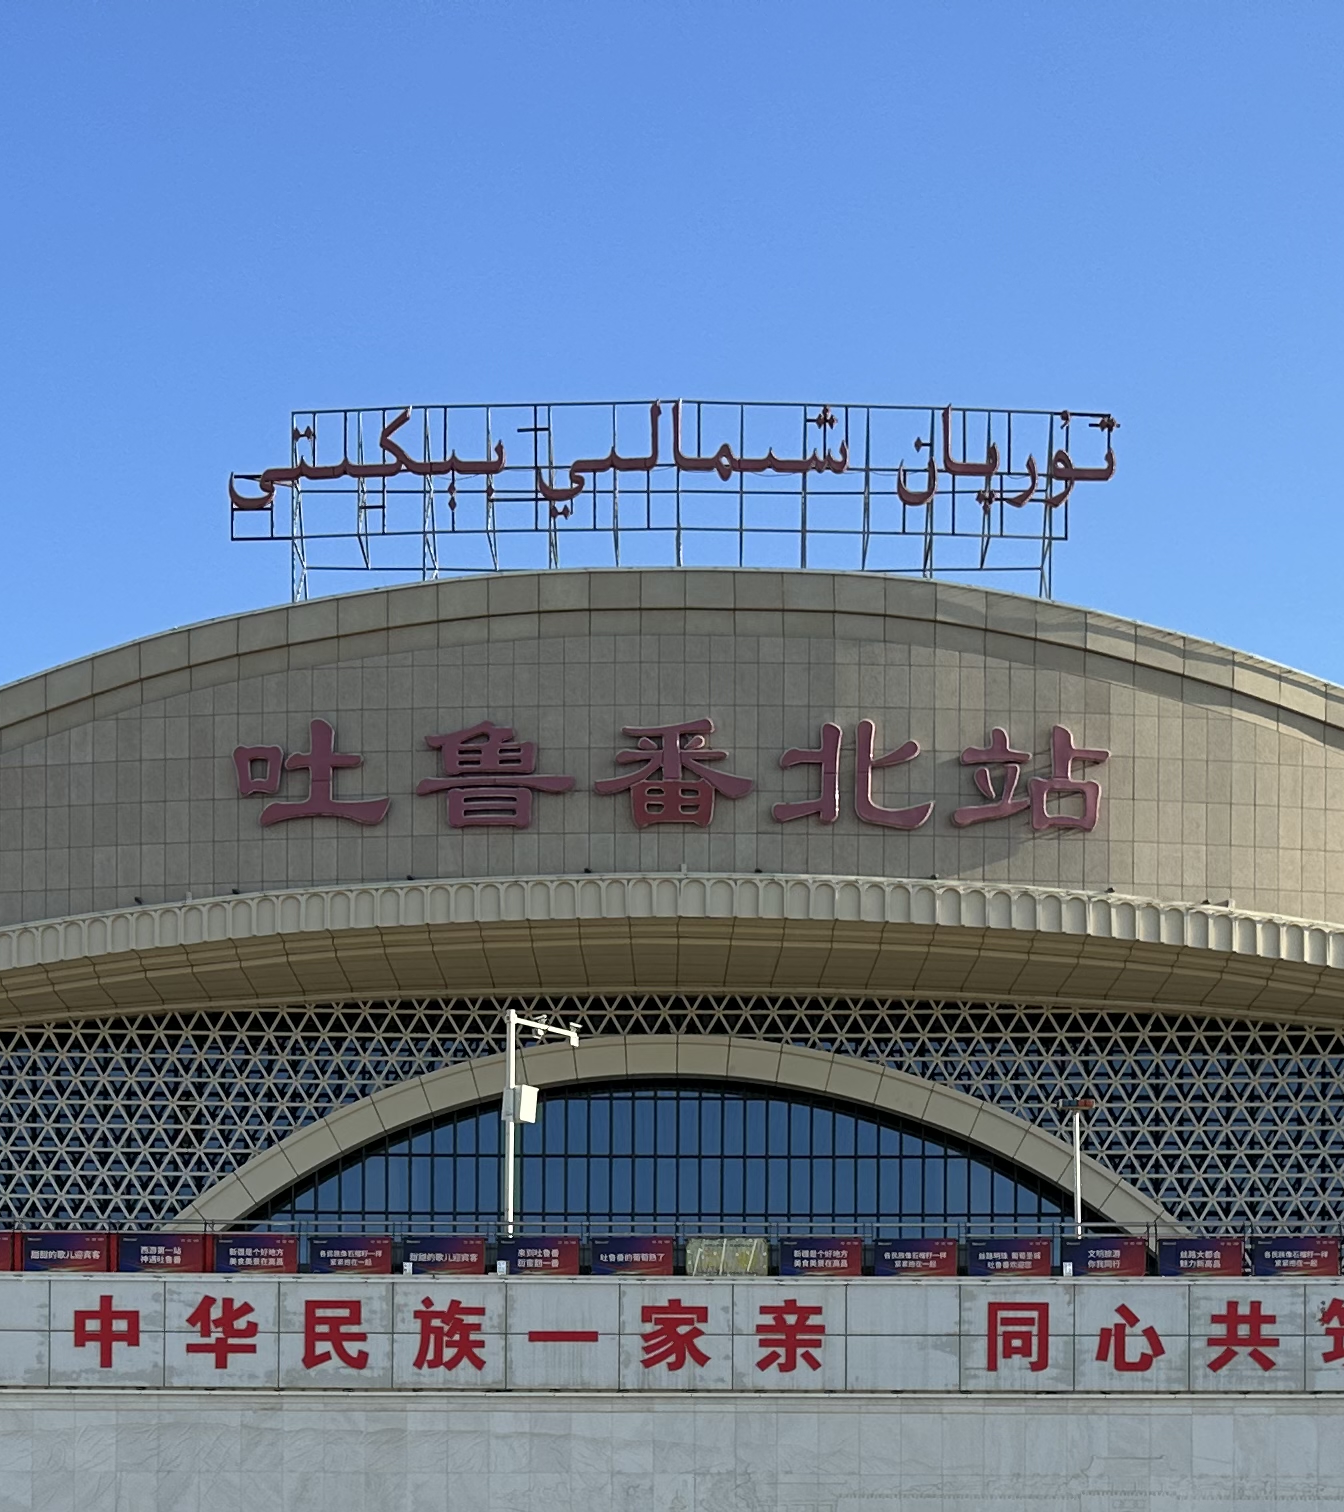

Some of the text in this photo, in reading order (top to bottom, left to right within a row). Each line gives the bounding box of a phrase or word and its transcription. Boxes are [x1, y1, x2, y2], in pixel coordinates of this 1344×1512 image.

[232, 717, 1110, 832] 吐鲁番北站
[599, 1253, 664, 1262] 吐鲁番的葡萄熟了
[72, 1295, 826, 1372] 中华民族一家亲
